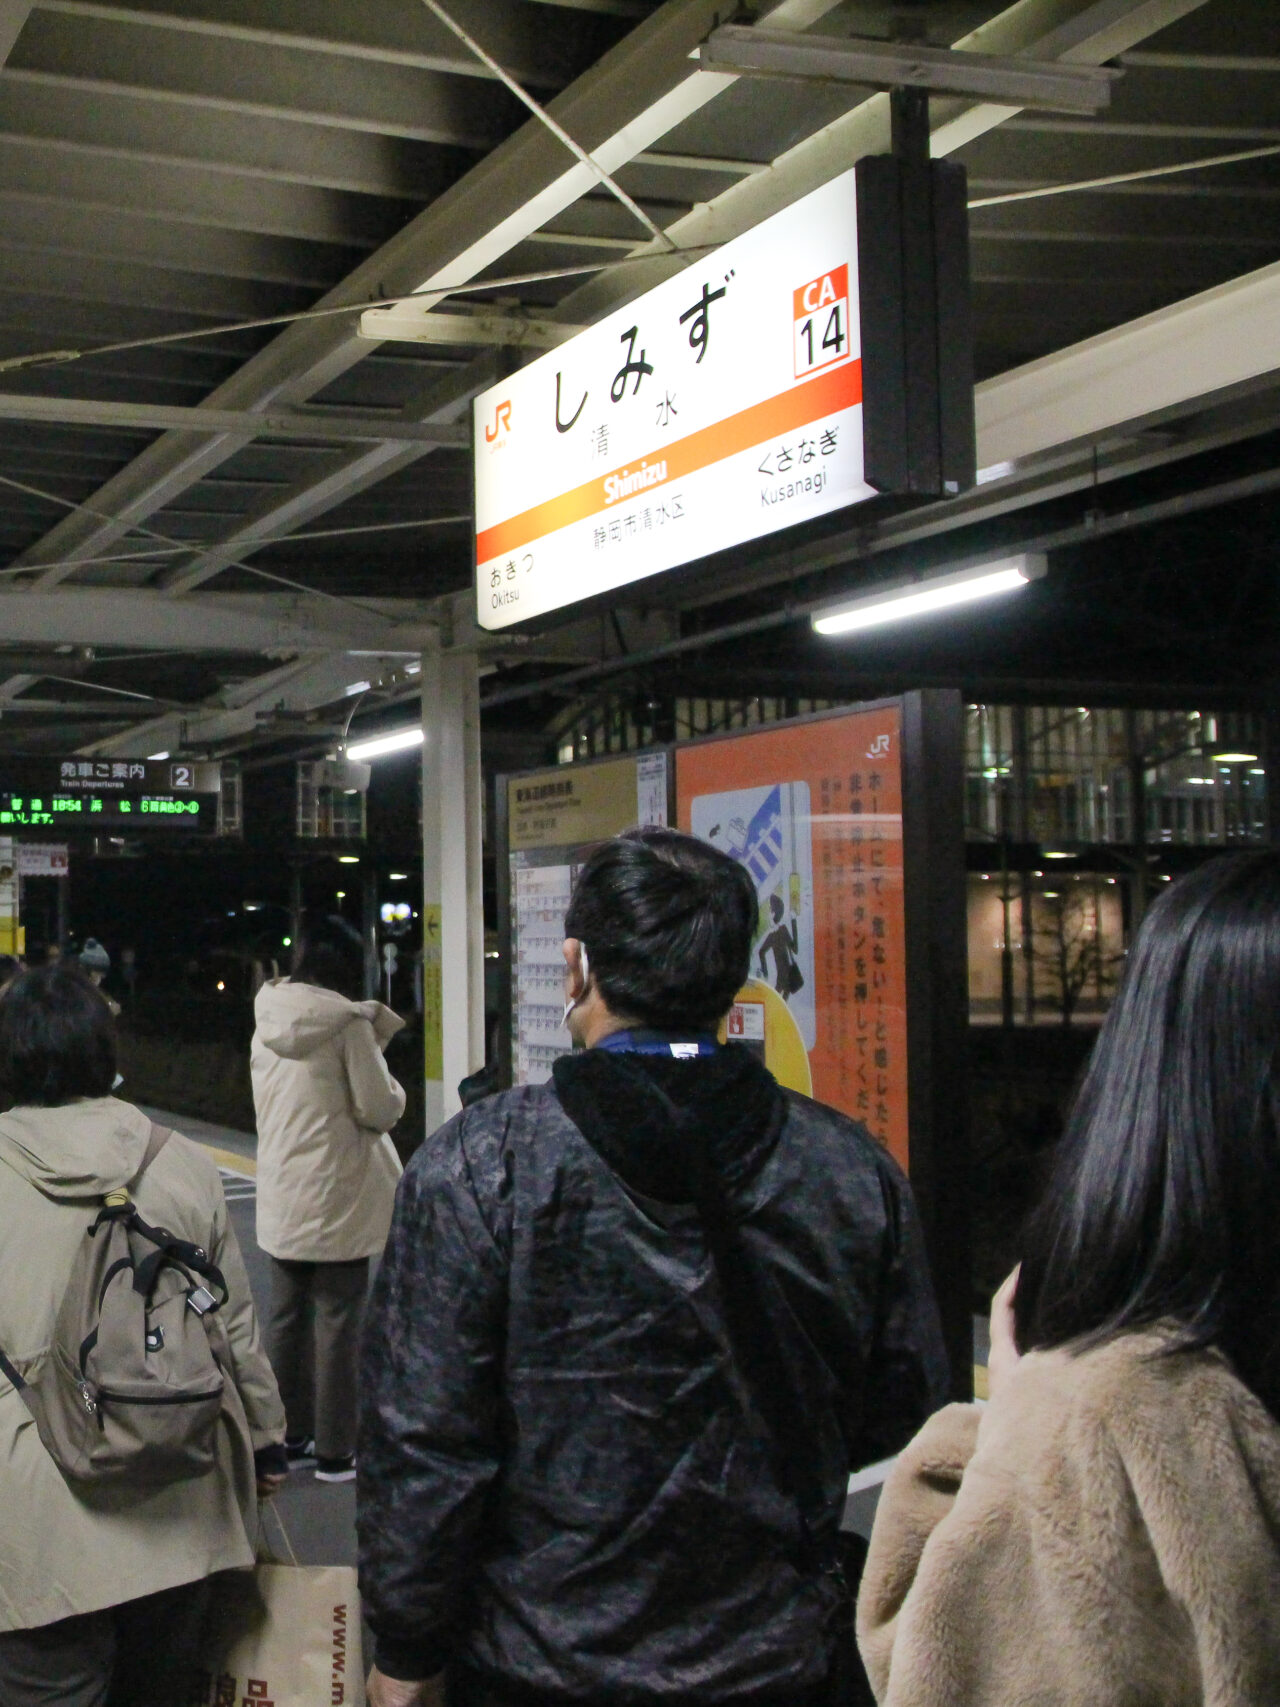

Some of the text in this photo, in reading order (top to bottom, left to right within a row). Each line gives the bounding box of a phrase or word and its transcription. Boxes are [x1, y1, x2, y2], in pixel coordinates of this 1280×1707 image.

[803, 275, 837, 312] CA
[556, 269, 735, 433] しみず
[801, 304, 845, 365] 14
[486, 400, 512, 442] JR
[758, 426, 839, 475] くさなぎ
[603, 461, 668, 504] Shimizu
[761, 465, 826, 507] Kusanagi
[490, 553, 534, 588] おきつ
[491, 588, 520, 609] Okitsu
[871, 734, 890, 754] JR
[60, 762, 145, 779] 発車ご案内
[61, 779, 80, 788] Train
[175, 767, 190, 786] 2
